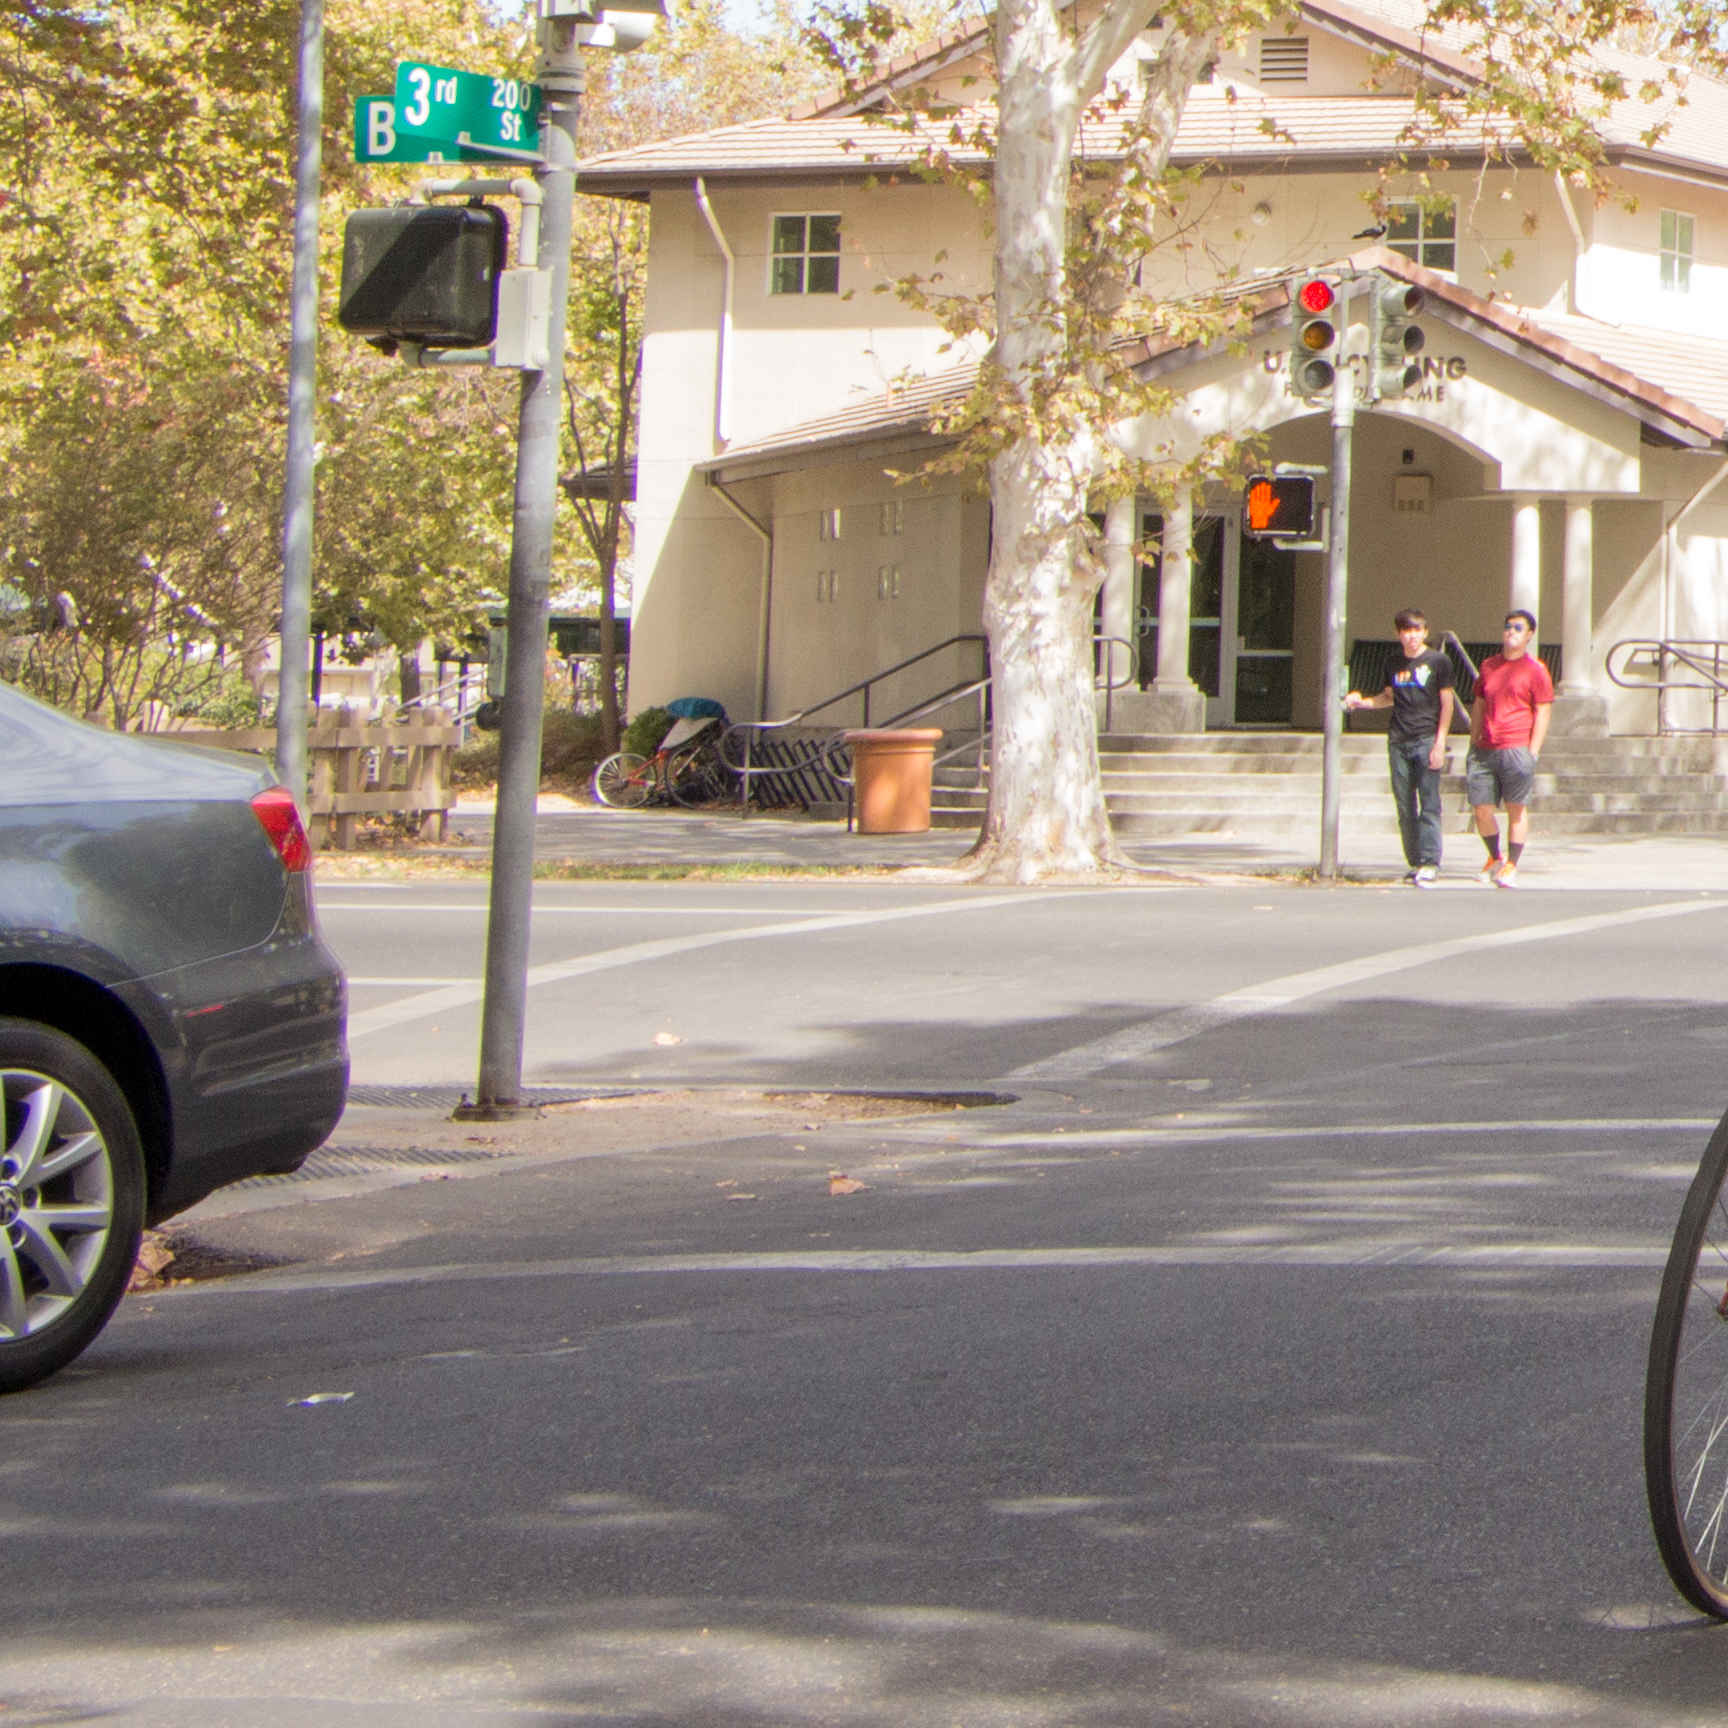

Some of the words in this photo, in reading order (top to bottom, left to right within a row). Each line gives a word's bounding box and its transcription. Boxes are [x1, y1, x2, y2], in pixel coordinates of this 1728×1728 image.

[404, 67, 458, 127] 3rd
[491, 78, 532, 112] 200
[367, 101, 397, 156] B
[500, 110, 523, 142] St
